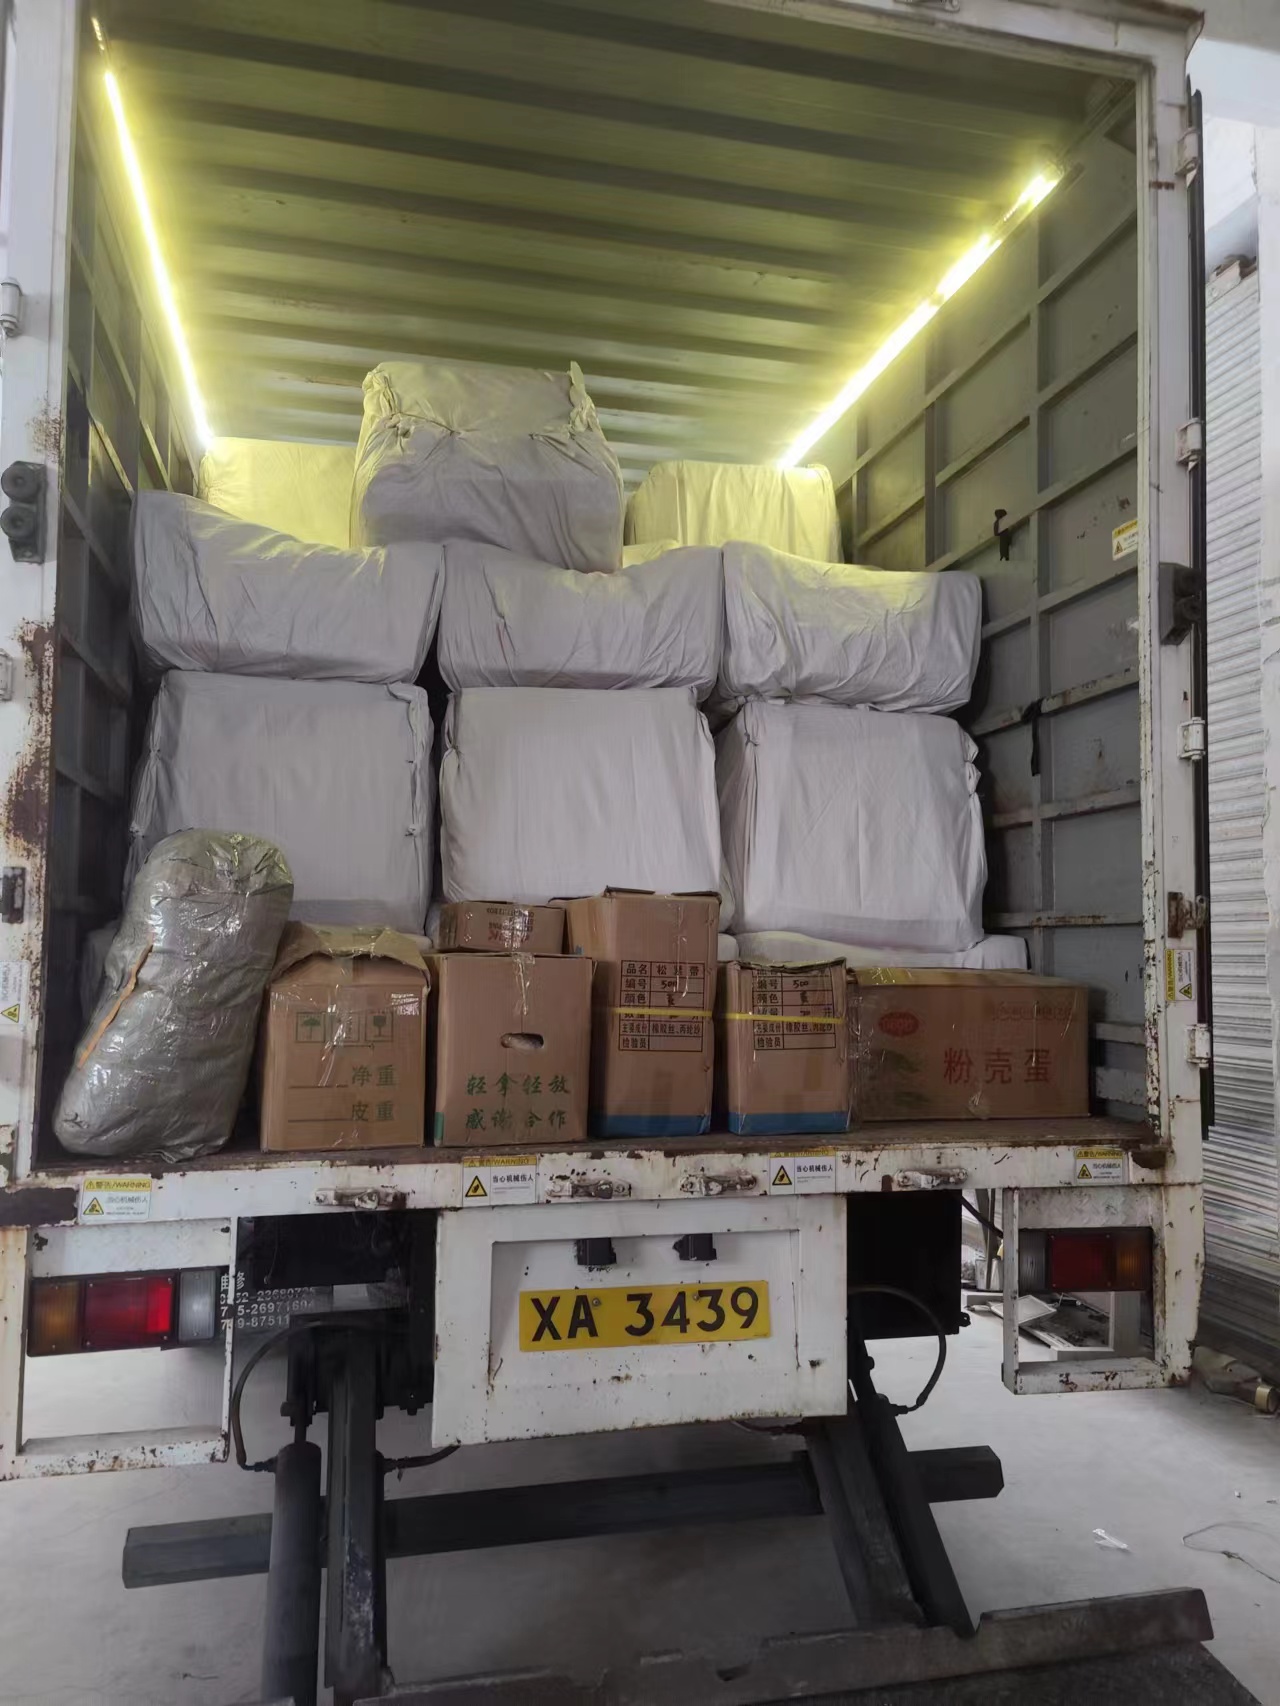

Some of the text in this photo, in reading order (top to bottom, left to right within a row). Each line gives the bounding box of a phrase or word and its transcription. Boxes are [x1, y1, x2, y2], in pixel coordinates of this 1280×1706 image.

[626, 963, 648, 975] 品名
[625, 978, 647, 990] 编号
[757, 978, 809, 990] 编号 500
[624, 993, 646, 1004] 颜色
[757, 993, 779, 1004] 颜色
[622, 1036, 647, 1049] 检验员
[757, 1036, 781, 1048] 检验员
[943, 1047, 1054, 1084] 粉壳蛋
[351, 1063, 399, 1087] 净重
[466, 1071, 571, 1097] 轻拿轻放
[351, 1099, 396, 1122] 皮重
[464, 1107, 566, 1132] 感谢合作
[796, 1163, 834, 1174] 当心机械伤人
[492, 1173, 534, 1184] 当心机械伤人
[531, 1286, 760, 1342] XA 3439
